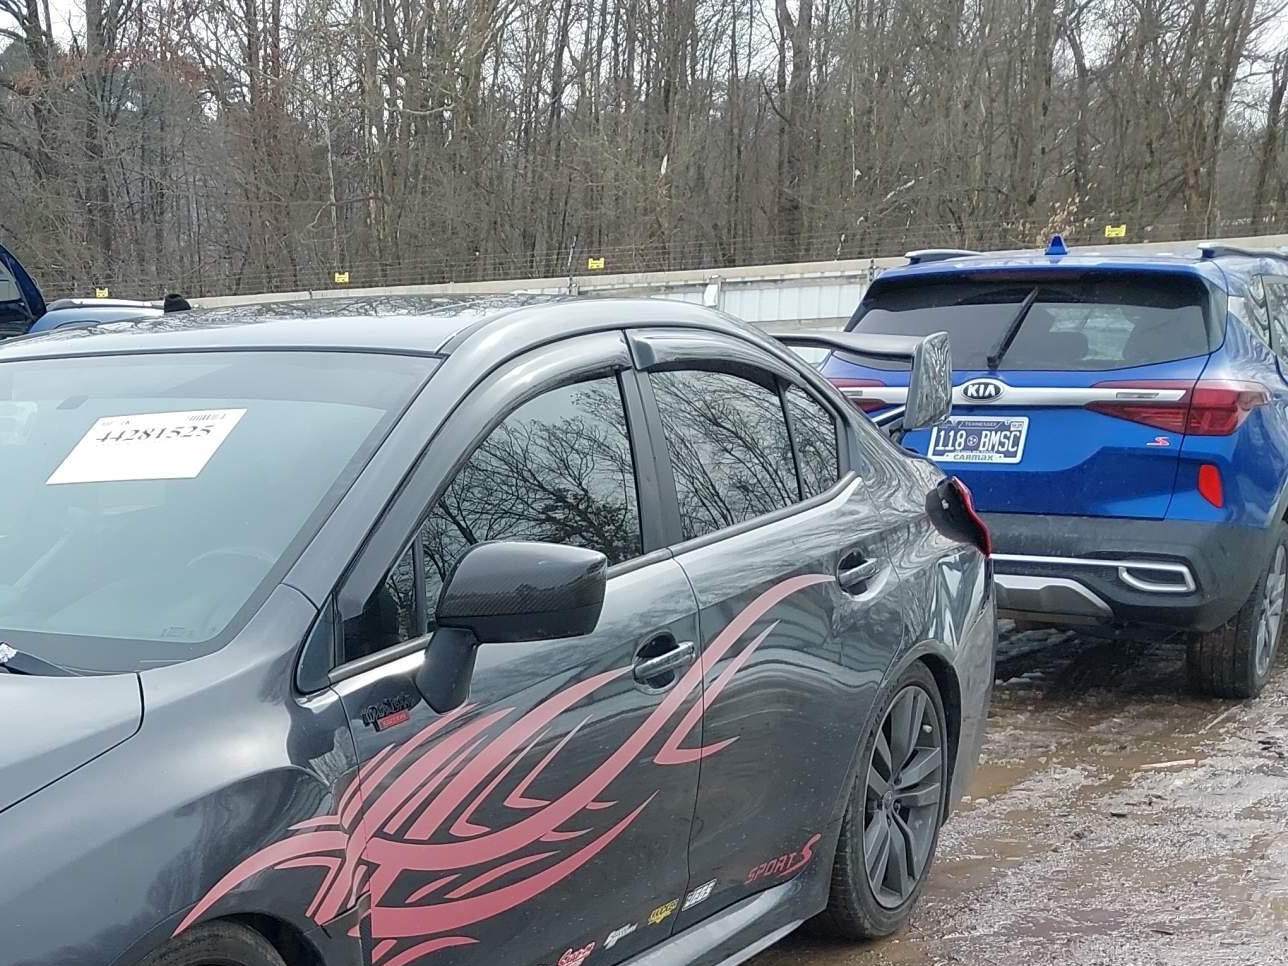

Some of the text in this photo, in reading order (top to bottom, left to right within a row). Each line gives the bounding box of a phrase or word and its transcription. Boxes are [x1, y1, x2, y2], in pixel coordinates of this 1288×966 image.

[966, 384, 996, 398] KIA
[96, 424, 216, 443] 44281525
[935, 430, 1020, 452] 118 BMSC
[744, 851, 798, 885] SPORT
